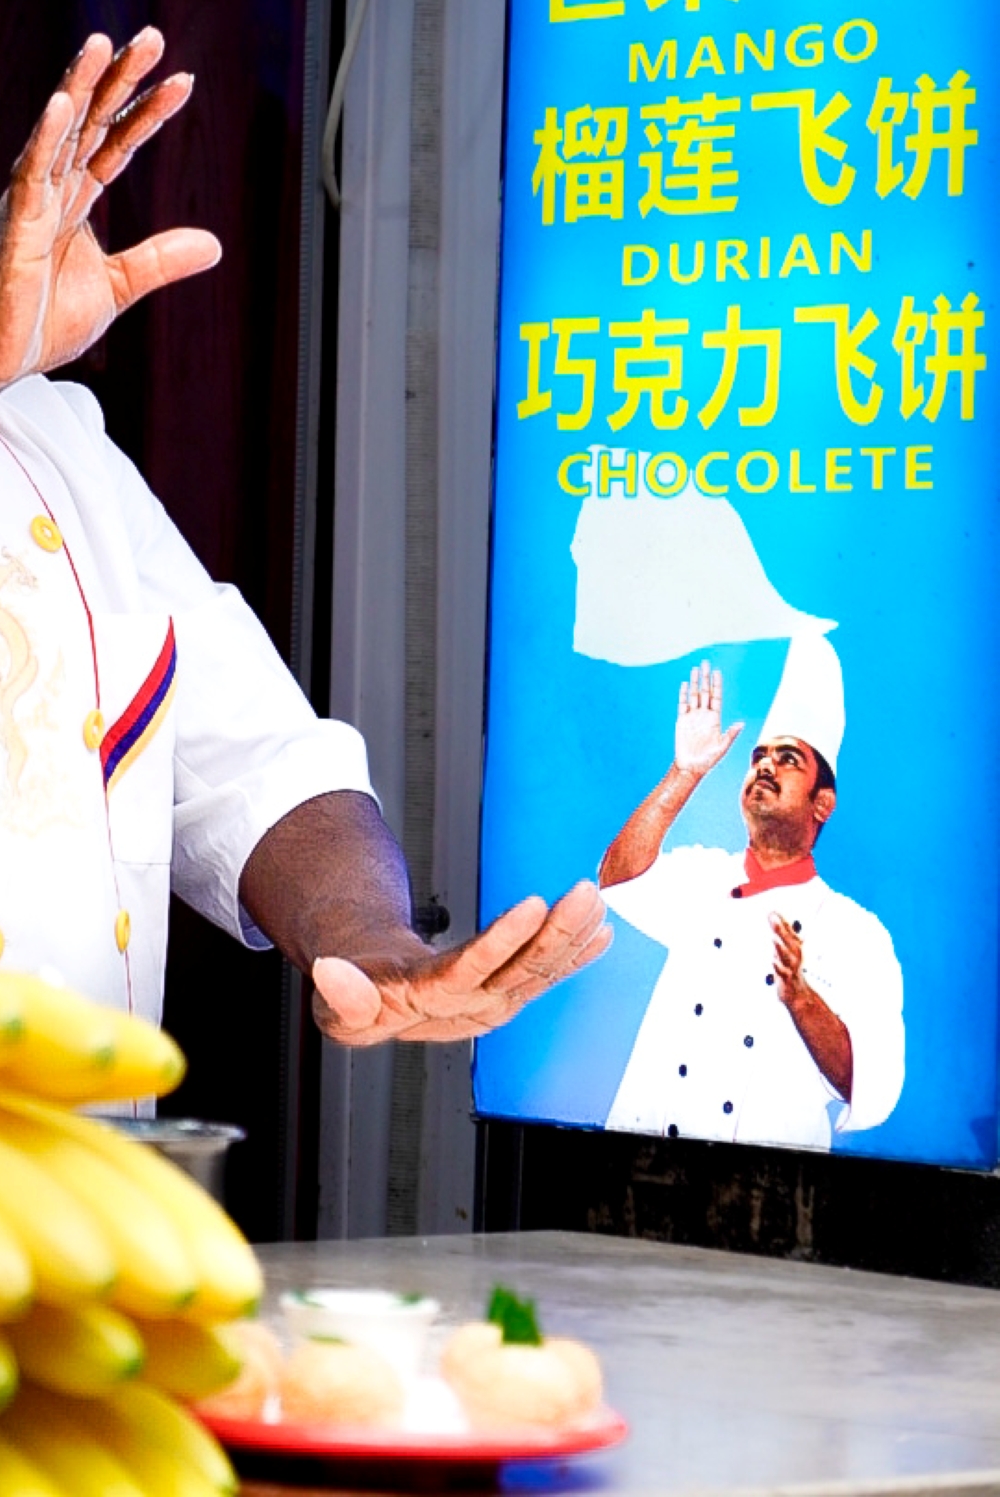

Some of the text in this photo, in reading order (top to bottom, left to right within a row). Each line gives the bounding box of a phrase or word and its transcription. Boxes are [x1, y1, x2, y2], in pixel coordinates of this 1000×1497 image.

[628, 18, 878, 83] MANGO
[531, 70, 978, 226] 榴莲飞饼
[621, 229, 872, 286] DURIAN
[517, 292, 987, 432] 巧克力飞饼
[557, 445, 934, 497] CHOCOLETE
